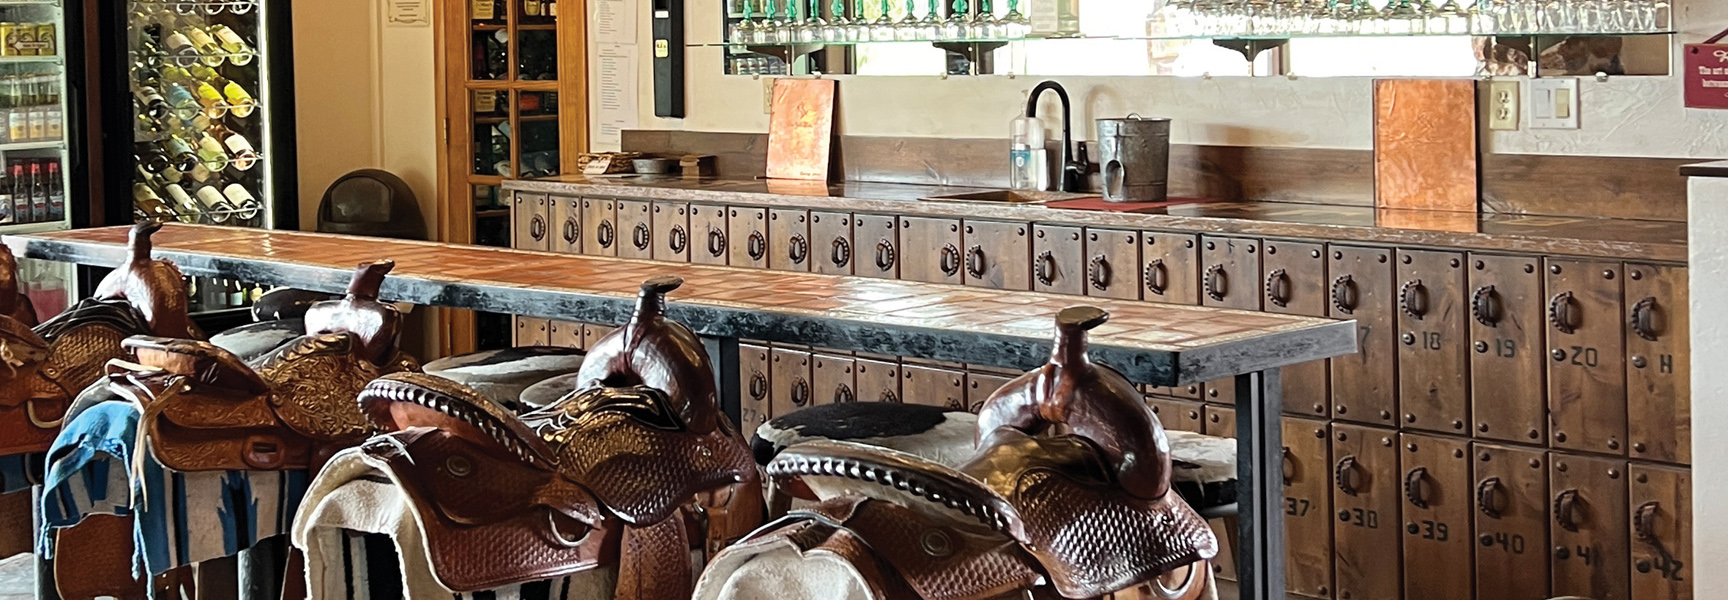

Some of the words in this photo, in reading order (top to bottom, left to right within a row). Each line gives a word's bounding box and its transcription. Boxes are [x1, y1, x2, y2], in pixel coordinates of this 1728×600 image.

[1422, 330, 1441, 351] 18
[1495, 338, 1516, 359] 19
[1570, 345, 1598, 368] 20
[1659, 353, 1673, 374] H
[1285, 496, 1310, 517] 37
[1421, 520, 1448, 542] 39
[1495, 532, 1525, 555] 40
[1653, 557, 1684, 581] 42
